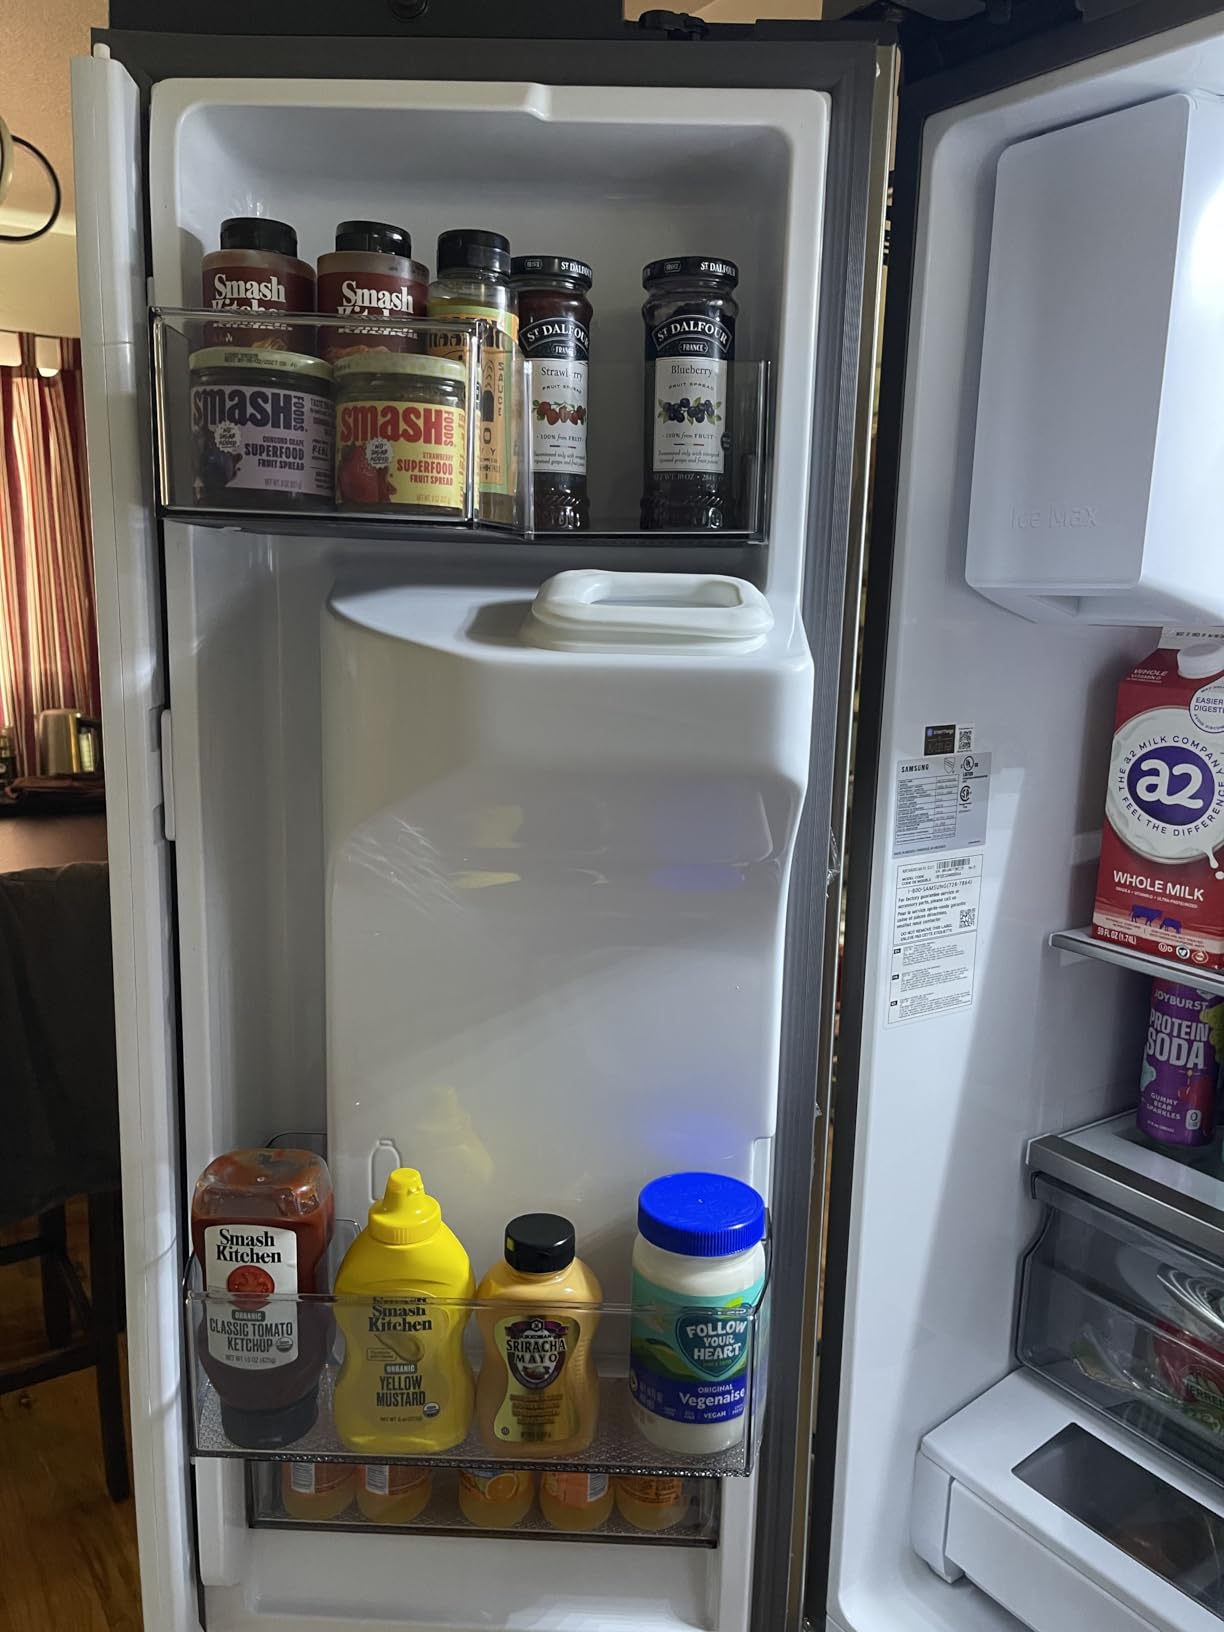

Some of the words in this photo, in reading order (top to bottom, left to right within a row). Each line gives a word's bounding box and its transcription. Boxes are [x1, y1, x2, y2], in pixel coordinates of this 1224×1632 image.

[214, 274, 286, 302] Smash
[343, 280, 413, 313] Smash
[671, 321, 727, 344] DALFOUR
[671, 365, 712, 378] Blueberry
[293, 396, 305, 432] FOODS
[444, 411, 454, 447] FOODS
[245, 443, 304, 460] SUPERFOOD
[258, 459, 278, 469] FRUIT
[279, 460, 304, 471] SPREAD
[397, 459, 453, 475] SUPERFOOD
[410, 474, 429, 484] FRUIT
[430, 476, 453, 486] SPREAD
[1196, 697, 1224, 705] EASIER
[901, 763, 929, 773] SAMSUNG
[1118, 768, 1126, 792] THE
[1139, 735, 1167, 750] MILK
[1172, 735, 1224, 775] COMPANY
[1137, 759, 1203, 809] a2
[1122, 796, 1143, 821] FEEL
[1146, 820, 1167, 834] THE
[1173, 781, 1224, 837] DIFFERENCE
[1113, 869, 1164, 893] WHOLE
[1167, 882, 1205, 902] MILK
[1111, 931, 1118, 939] OZ
[1154, 989, 1208, 1010] JOYBURST
[1150, 1008, 1209, 1041] PROTEIN
[1147, 1027, 1205, 1069] SODA
[1151, 1092, 1178, 1105] GUMMY
[1154, 1100, 1172, 1111] BEAR
[1147, 1104, 1181, 1120] SPARKLES
[219, 1228, 274, 1247] Smash
[216, 1245, 281, 1263] Kitchen
[372, 1305, 426, 1318] Smash
[210, 1318, 249, 1337] CLASSIC
[251, 1322, 293, 1337] TOMATO
[368, 1317, 432, 1332] Kitchen
[686, 1321, 747, 1338] FOLLOW
[227, 1338, 272, 1352] KETCHUP
[507, 1339, 566, 1353] SRIRACHA
[704, 1335, 735, 1347] YOUR
[516, 1353, 557, 1363] MAYO
[694, 1343, 741, 1360] HEART
[387, 1365, 415, 1373] ORGANIC
[380, 1376, 422, 1391] YELLOW
[698, 1383, 733, 1394] ORIGINAL
[376, 1391, 426, 1407] MUSTARD
[679, 1388, 745, 1409] Vegenaise
[703, 1410, 726, 1419] VEGAN
